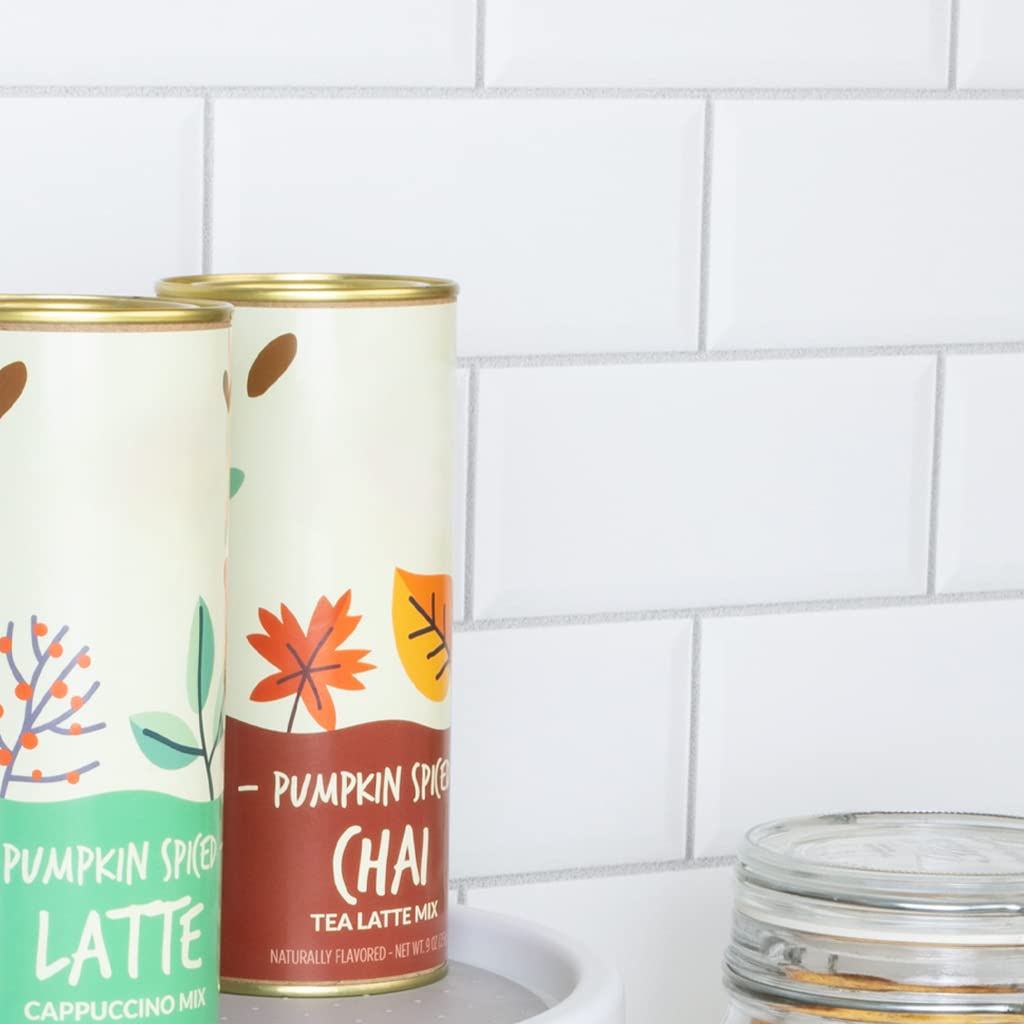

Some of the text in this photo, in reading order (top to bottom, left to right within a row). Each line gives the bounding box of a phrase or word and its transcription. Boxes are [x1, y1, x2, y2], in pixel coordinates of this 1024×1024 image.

[273, 765, 402, 809] PUMPKIN
[2, 841, 150, 886] PUMPKIN
[160, 832, 217, 882] SPICED
[333, 824, 429, 906] CHAI
[310, 900, 439, 932] TEA LATTE MIX
[35, 895, 206, 987] LATTE
[270, 948, 333, 966] NATURALLY
[336, 946, 387, 965] FLAVORED
[395, 942, 410, 960] NET
[24, 987, 207, 1022] CAPPUCCINO MIX
